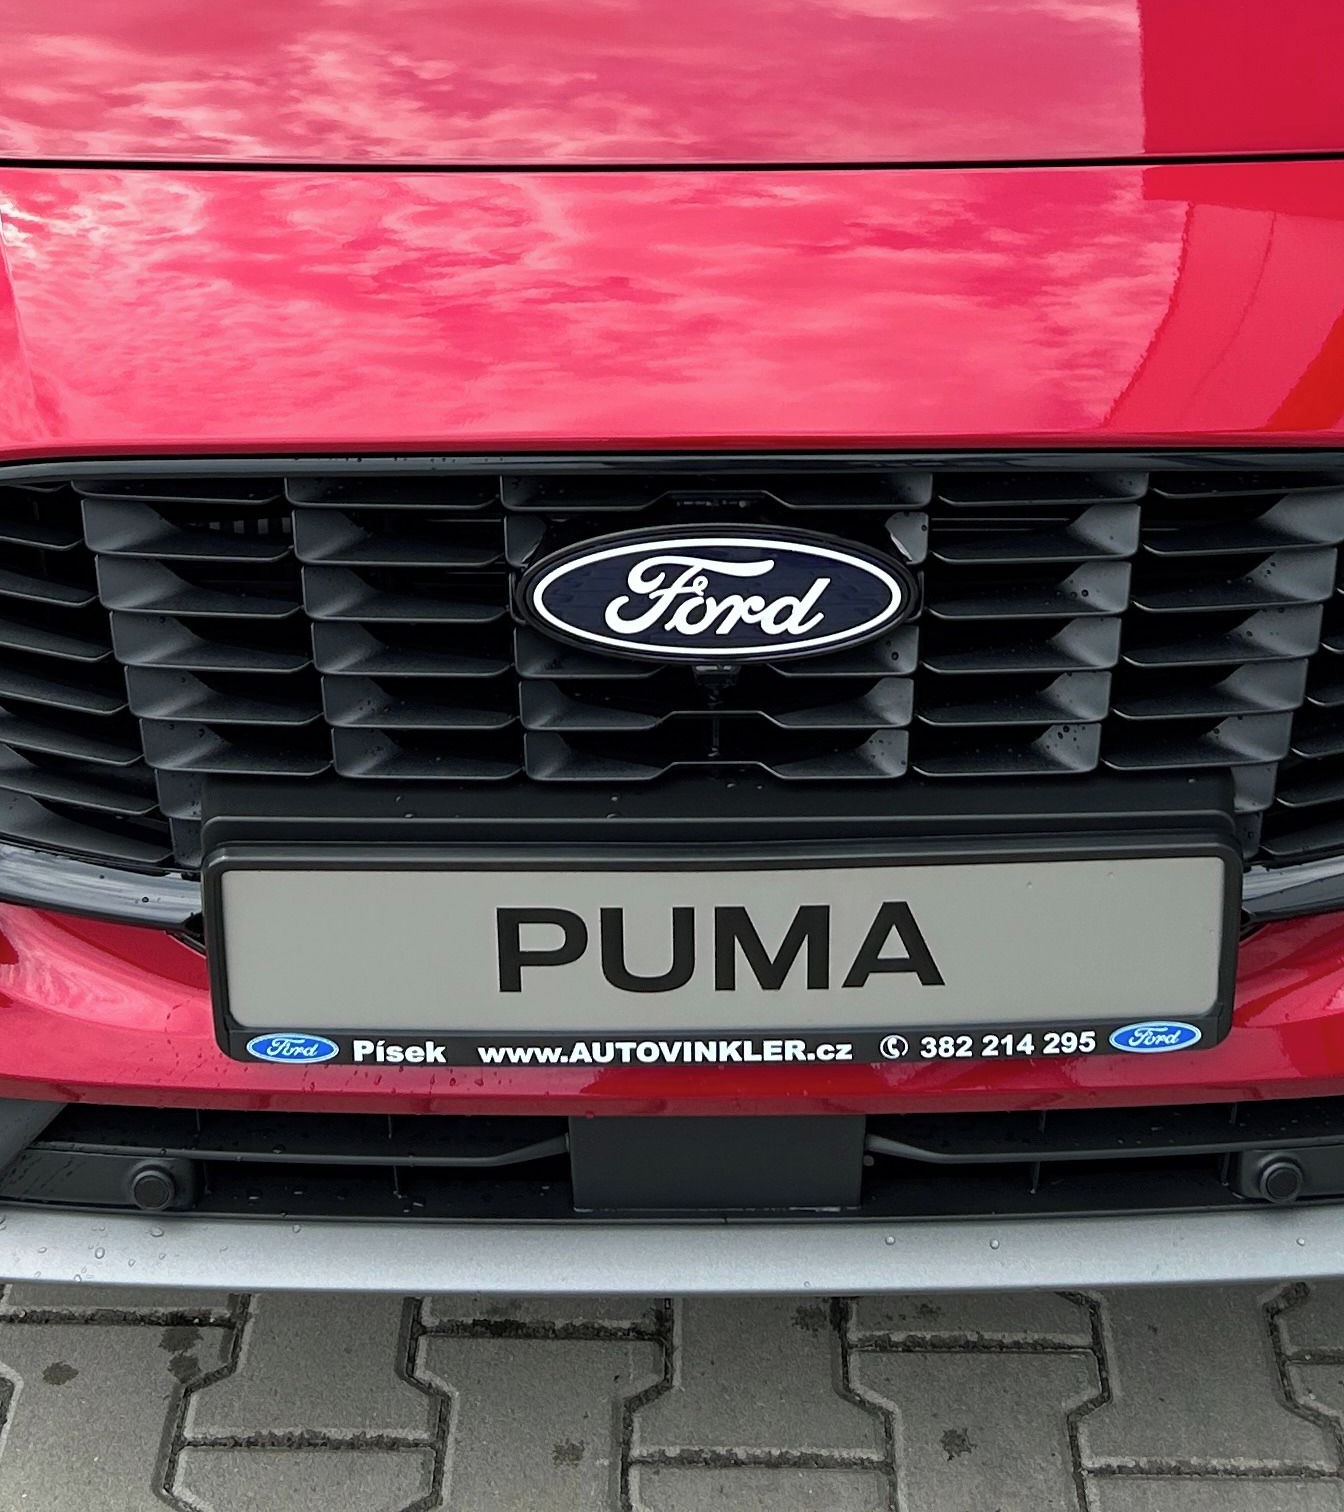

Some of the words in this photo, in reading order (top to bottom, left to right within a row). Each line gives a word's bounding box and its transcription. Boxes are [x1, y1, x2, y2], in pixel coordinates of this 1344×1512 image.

[600, 551, 835, 639] Ford
[496, 900, 946, 993] PUMA
[260, 1035, 326, 1060] Ford
[353, 1039, 448, 1063] Písek
[477, 1039, 853, 1064] www.AUTOVINKLER.cz
[919, 1035, 974, 1058] 382
[980, 1033, 1035, 1057] 214
[1042, 1031, 1097, 1054] 295
[1122, 1023, 1186, 1050] Ford
